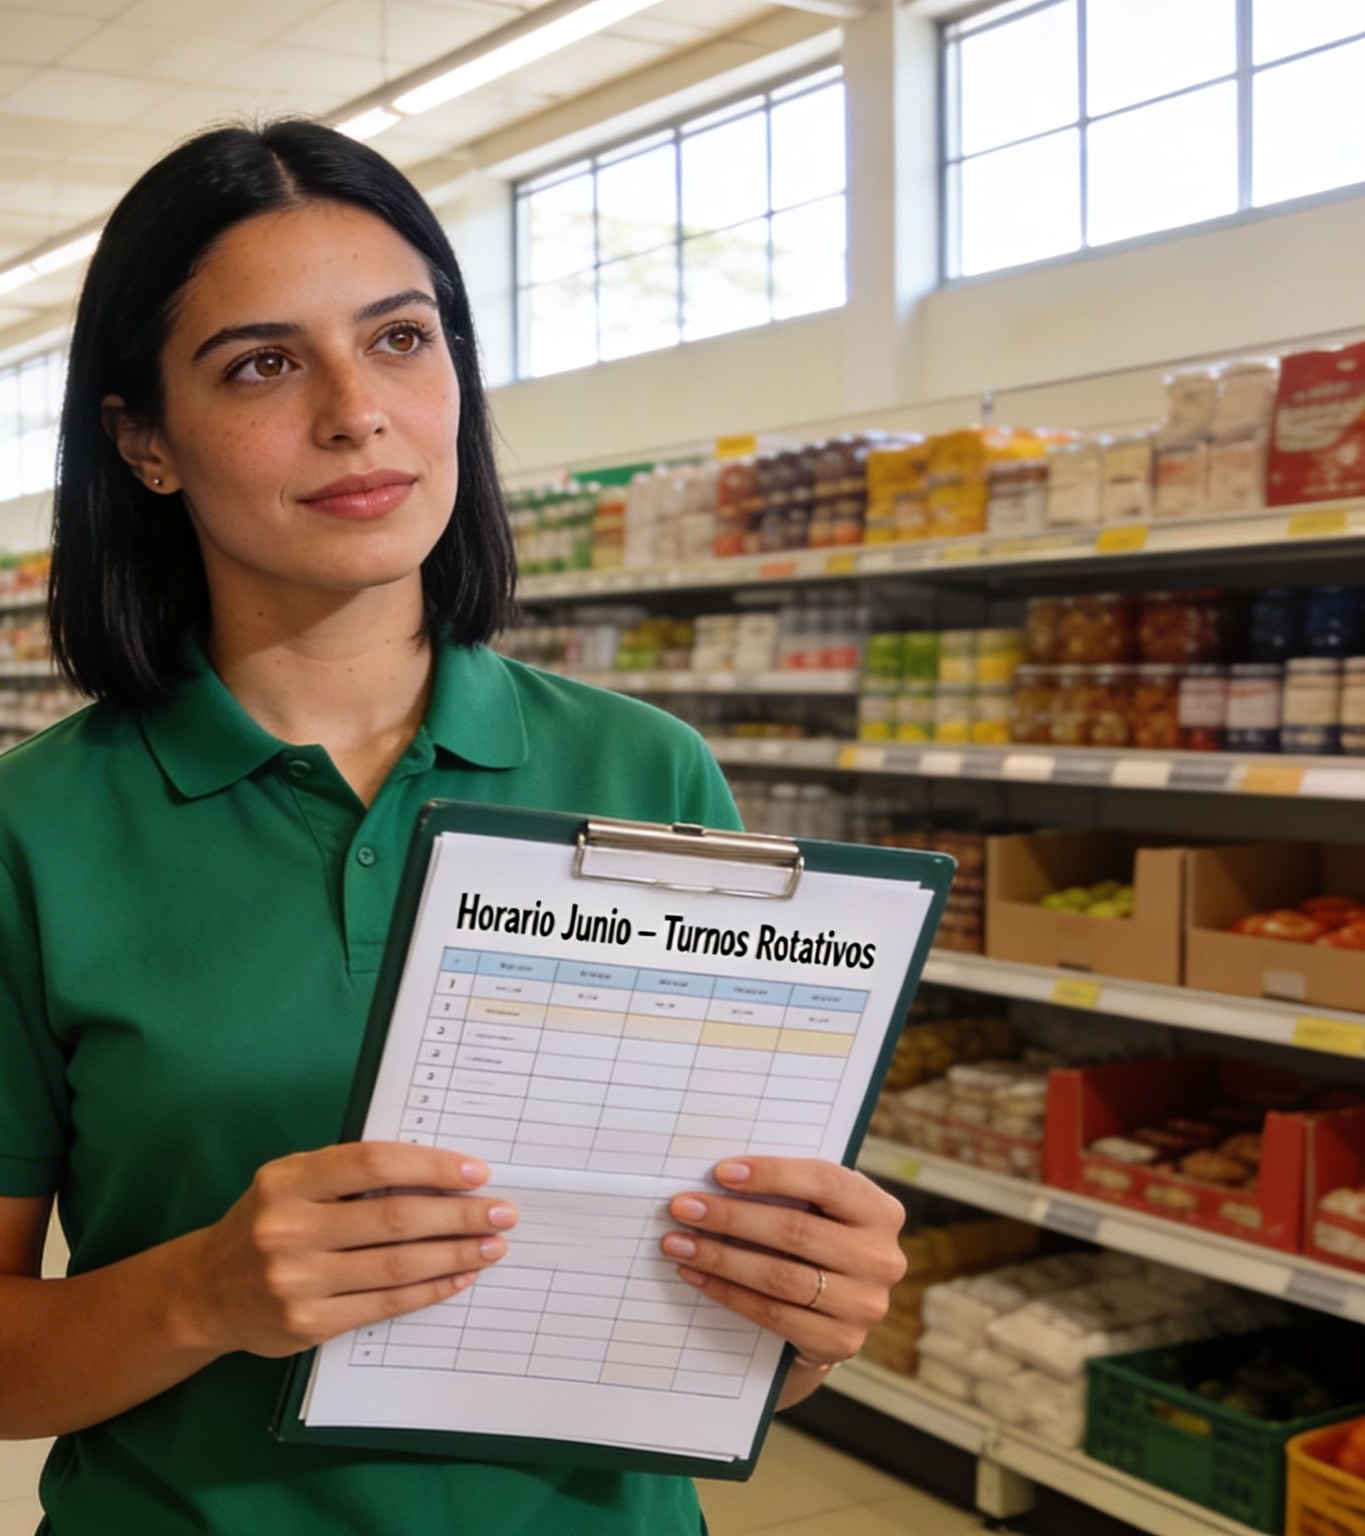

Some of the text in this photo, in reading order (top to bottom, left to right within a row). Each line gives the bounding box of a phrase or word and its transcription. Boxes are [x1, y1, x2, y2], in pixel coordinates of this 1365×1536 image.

[456, 892, 555, 937] Horario
[561, 904, 632, 946] Junio
[665, 915, 750, 958] Turnos
[756, 925, 876, 970] Rotativos
